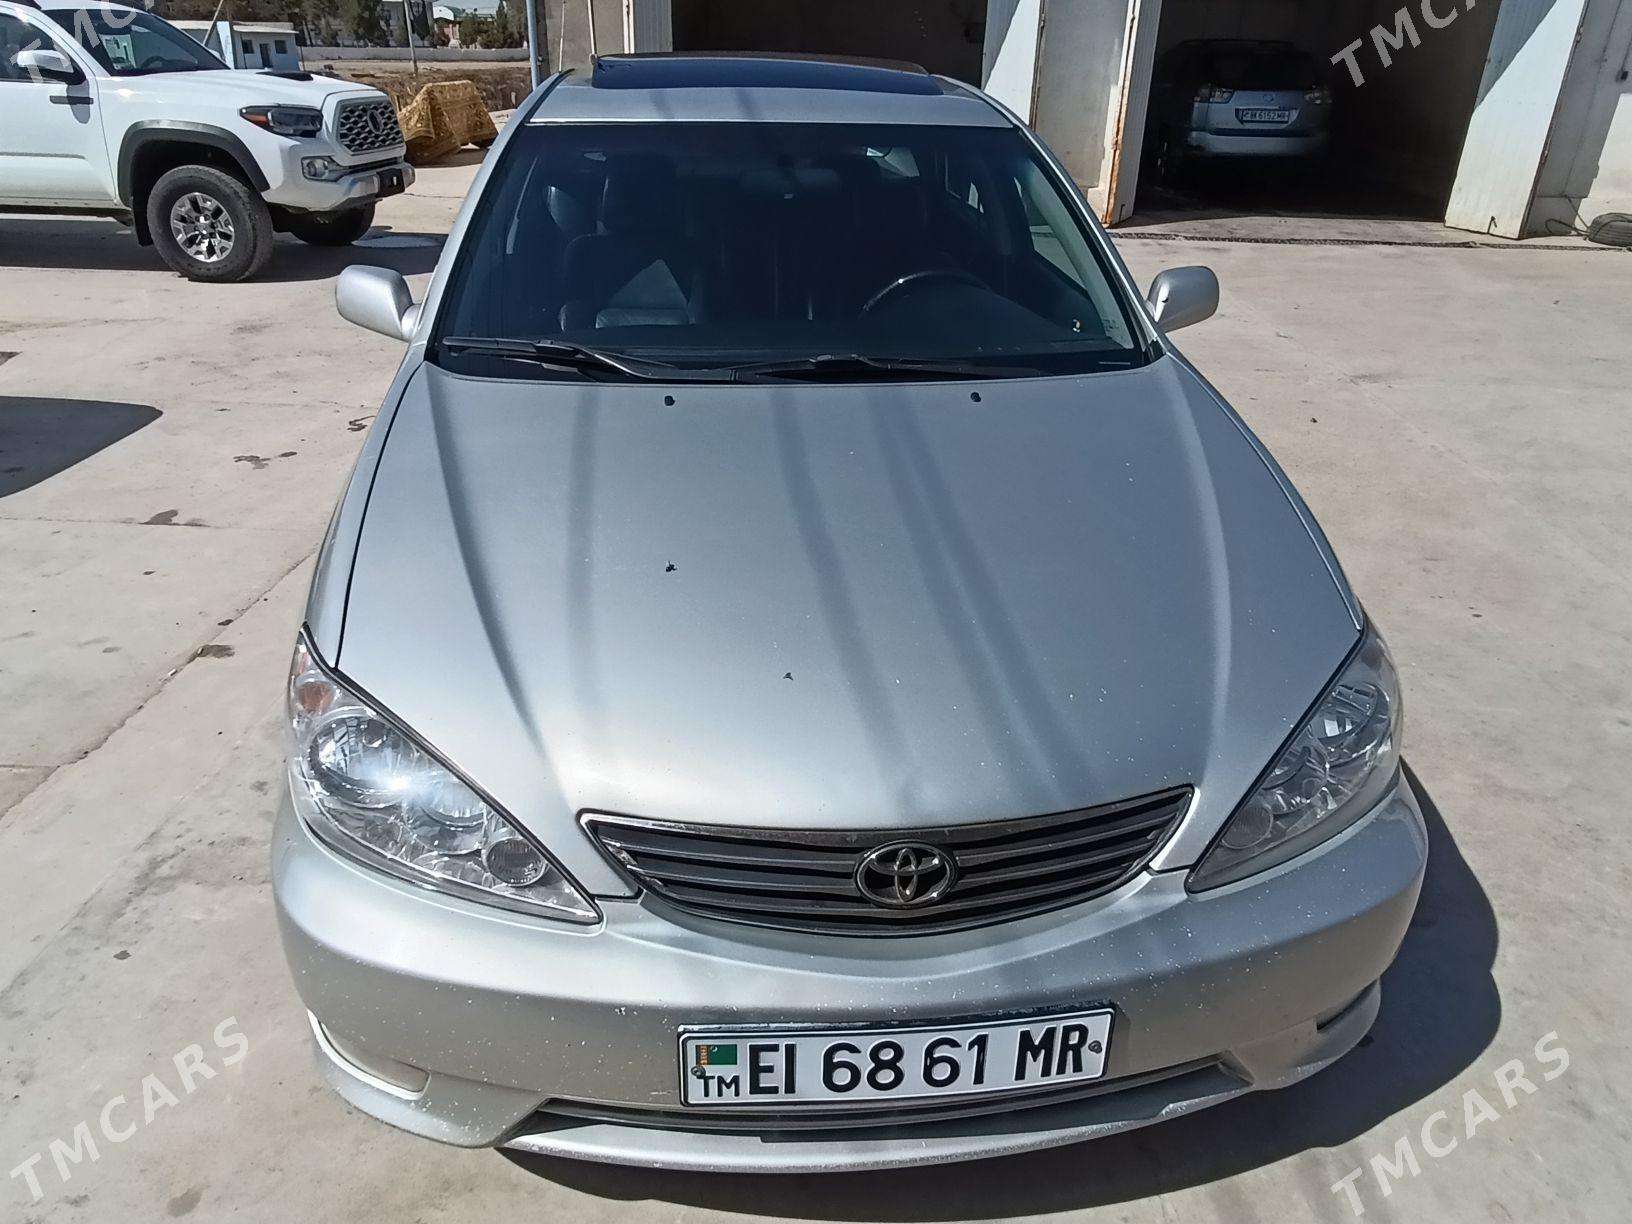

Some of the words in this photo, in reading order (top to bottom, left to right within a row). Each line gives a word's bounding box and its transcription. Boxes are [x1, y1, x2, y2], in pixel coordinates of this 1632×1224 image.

[748, 1043, 796, 1095] EI
[822, 1040, 904, 1093] 68
[922, 1034, 988, 1088] 61
[1014, 1023, 1089, 1081] MR
[701, 1075, 740, 1098] TM
